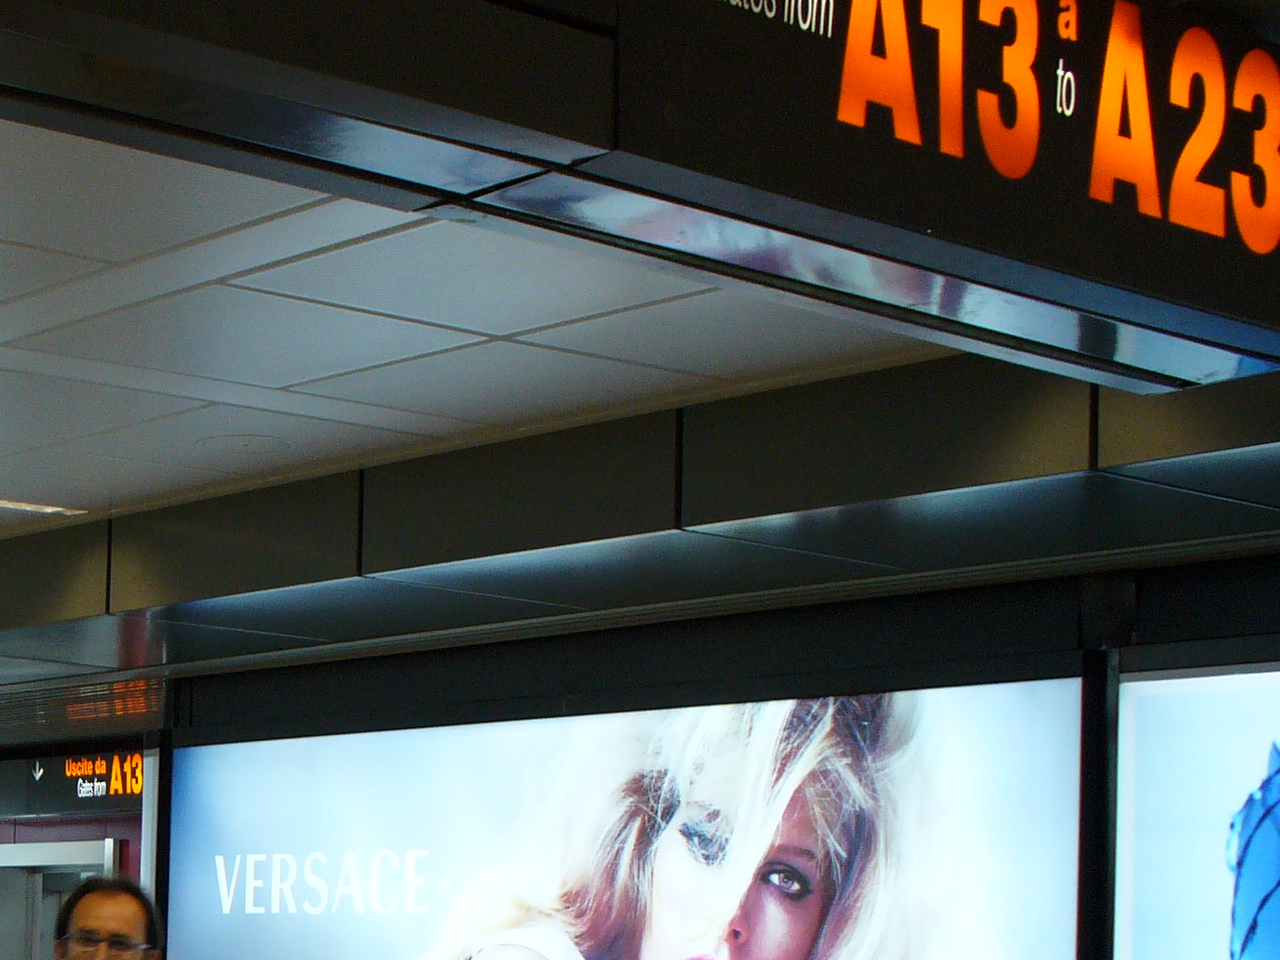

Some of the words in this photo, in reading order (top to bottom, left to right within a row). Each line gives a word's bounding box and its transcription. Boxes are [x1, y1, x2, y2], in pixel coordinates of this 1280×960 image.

[1056, 58, 1076, 117] to
[837, 0, 1041, 179] A13
[1057, 0, 1078, 42] a
[1089, 0, 1280, 255] A23
[65, 757, 94, 778] Uscite
[95, 755, 107, 775] da
[109, 753, 143, 796] A13
[214, 849, 430, 916] VERSACE
